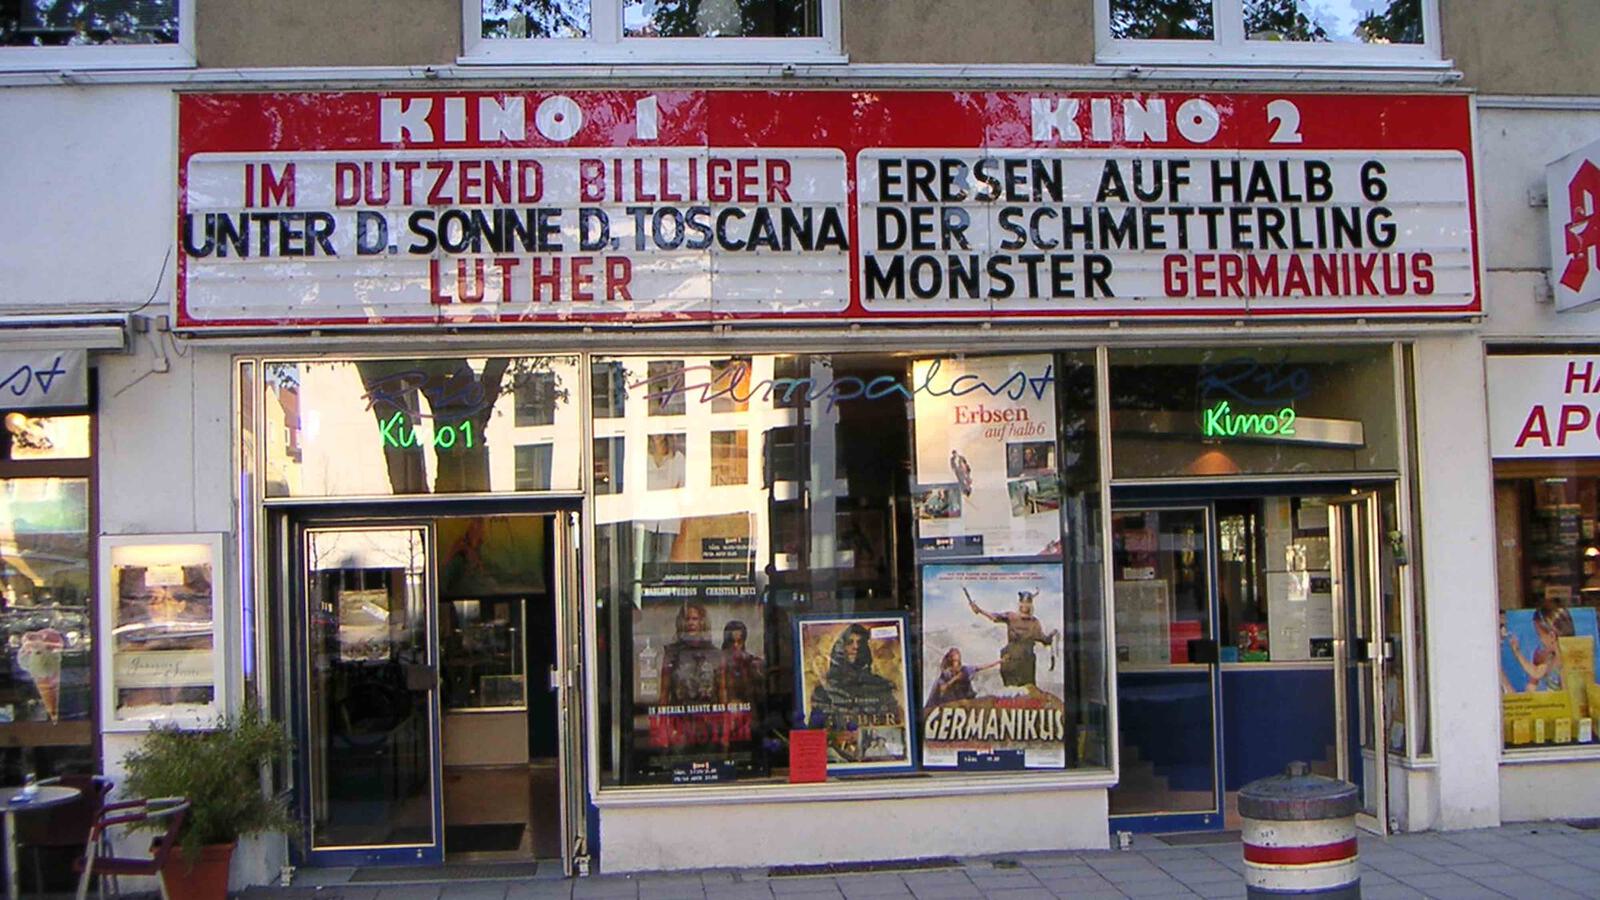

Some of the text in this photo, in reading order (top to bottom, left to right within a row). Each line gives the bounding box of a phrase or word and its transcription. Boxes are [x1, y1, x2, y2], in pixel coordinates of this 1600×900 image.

[379, 94, 659, 142] KINO 1
[1031, 97, 1303, 144] KINO 2
[245, 156, 794, 207] IM DUTZEND BILLIGER
[878, 158, 1389, 203] ERBSEN AUF HALB 6
[183, 209, 337, 259] UNTER
[408, 206, 563, 254] SONNE
[876, 206, 1397, 251] DER SCHMETTERLING
[429, 255, 633, 305] LUTHER
[864, 253, 1434, 299] MONSTER GERMANIKUS
[630, 357, 1055, 414] Filmpalast
[1564, 361, 1600, 394] H
[955, 406, 1029, 425] Erbsen
[984, 425, 1008, 440] auf
[1514, 404, 1600, 448] AP
[924, 706, 1065, 740] GERMANIKUS
